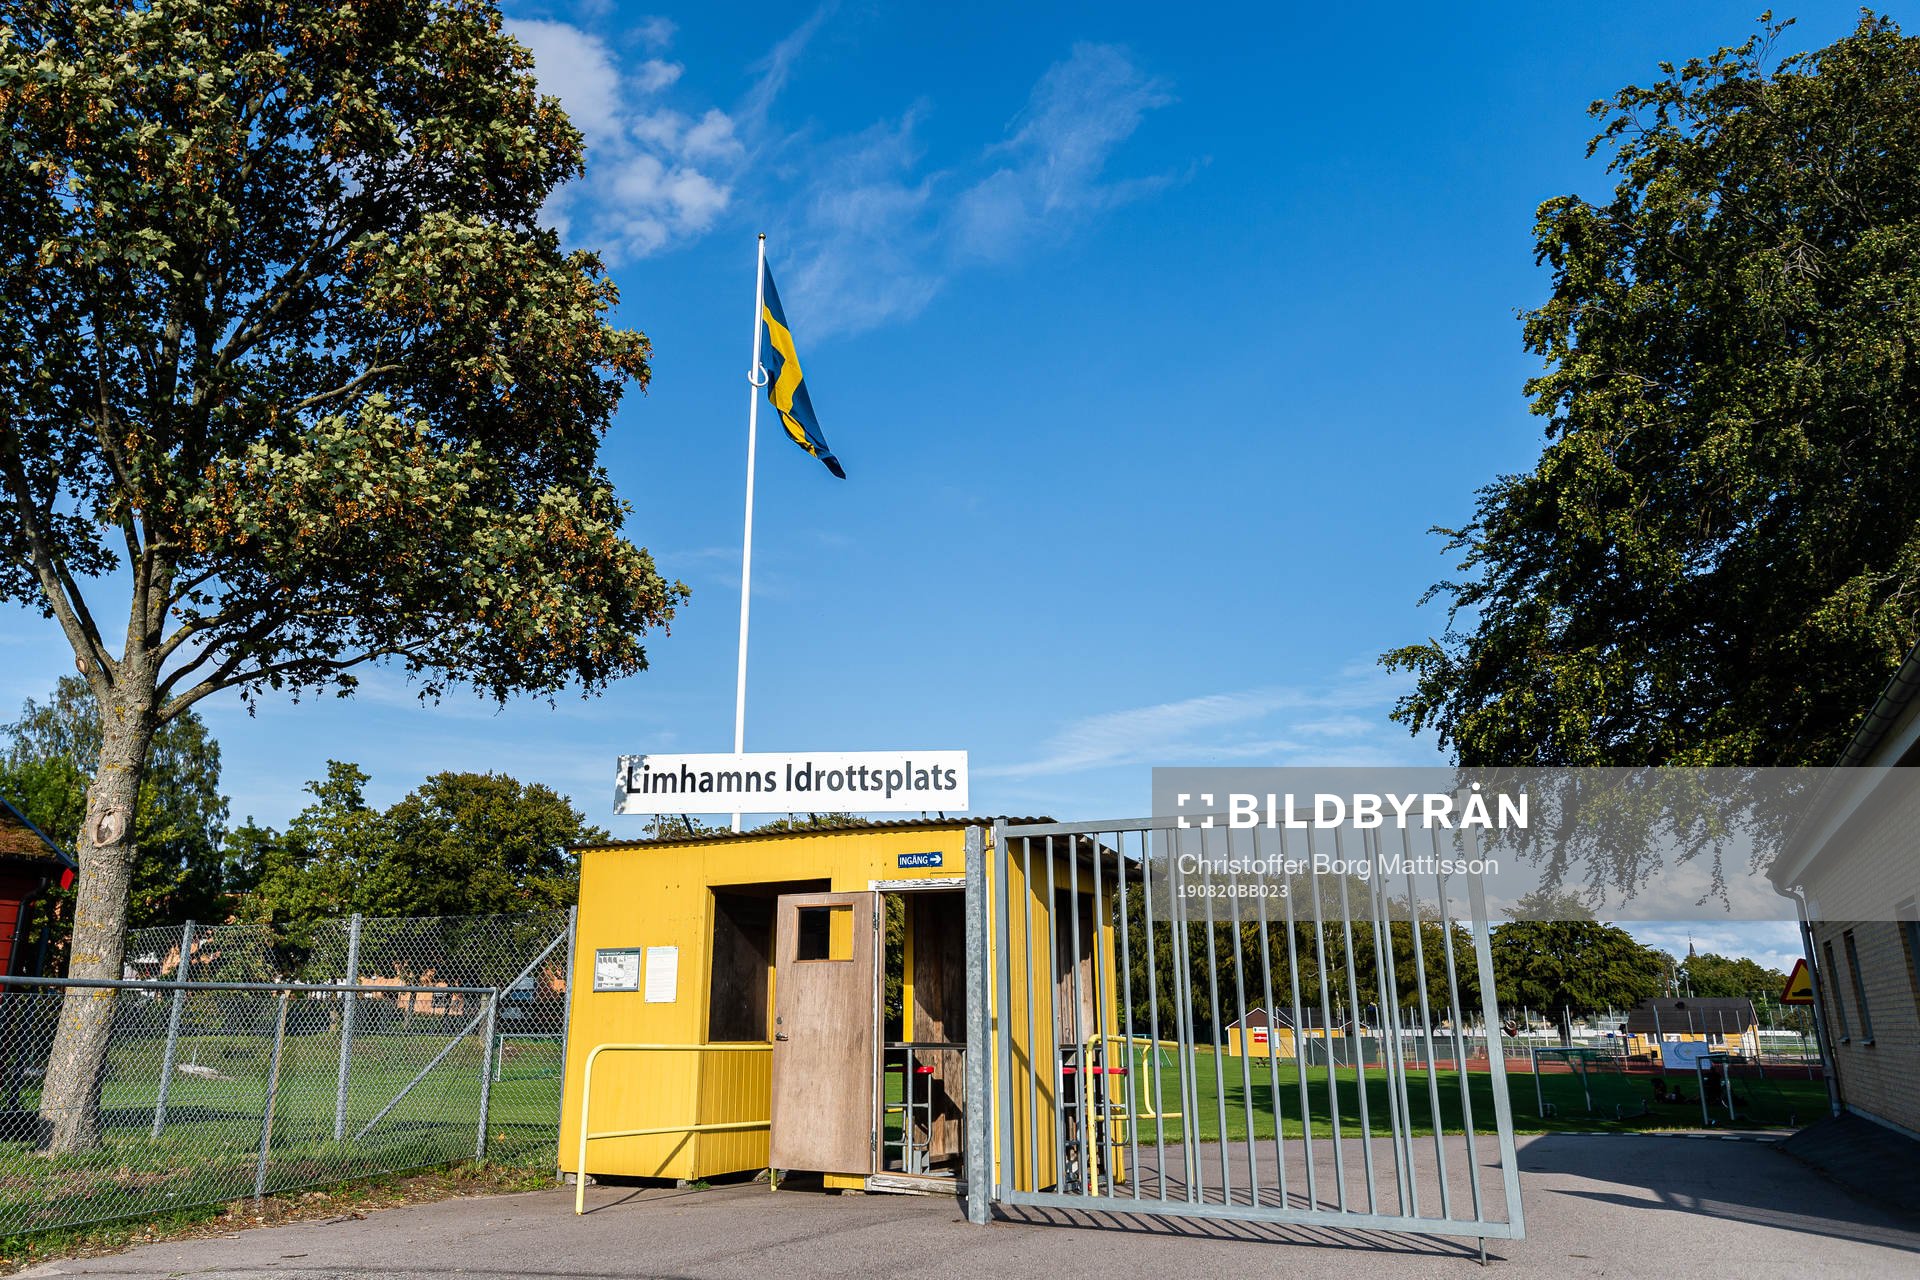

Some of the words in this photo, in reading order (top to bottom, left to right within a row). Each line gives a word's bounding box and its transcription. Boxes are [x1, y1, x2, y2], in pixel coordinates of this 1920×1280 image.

[626, 763, 777, 794] Limhamns
[786, 761, 957, 798] Idrottsplats
[899, 854, 929, 866] INGÅNG
